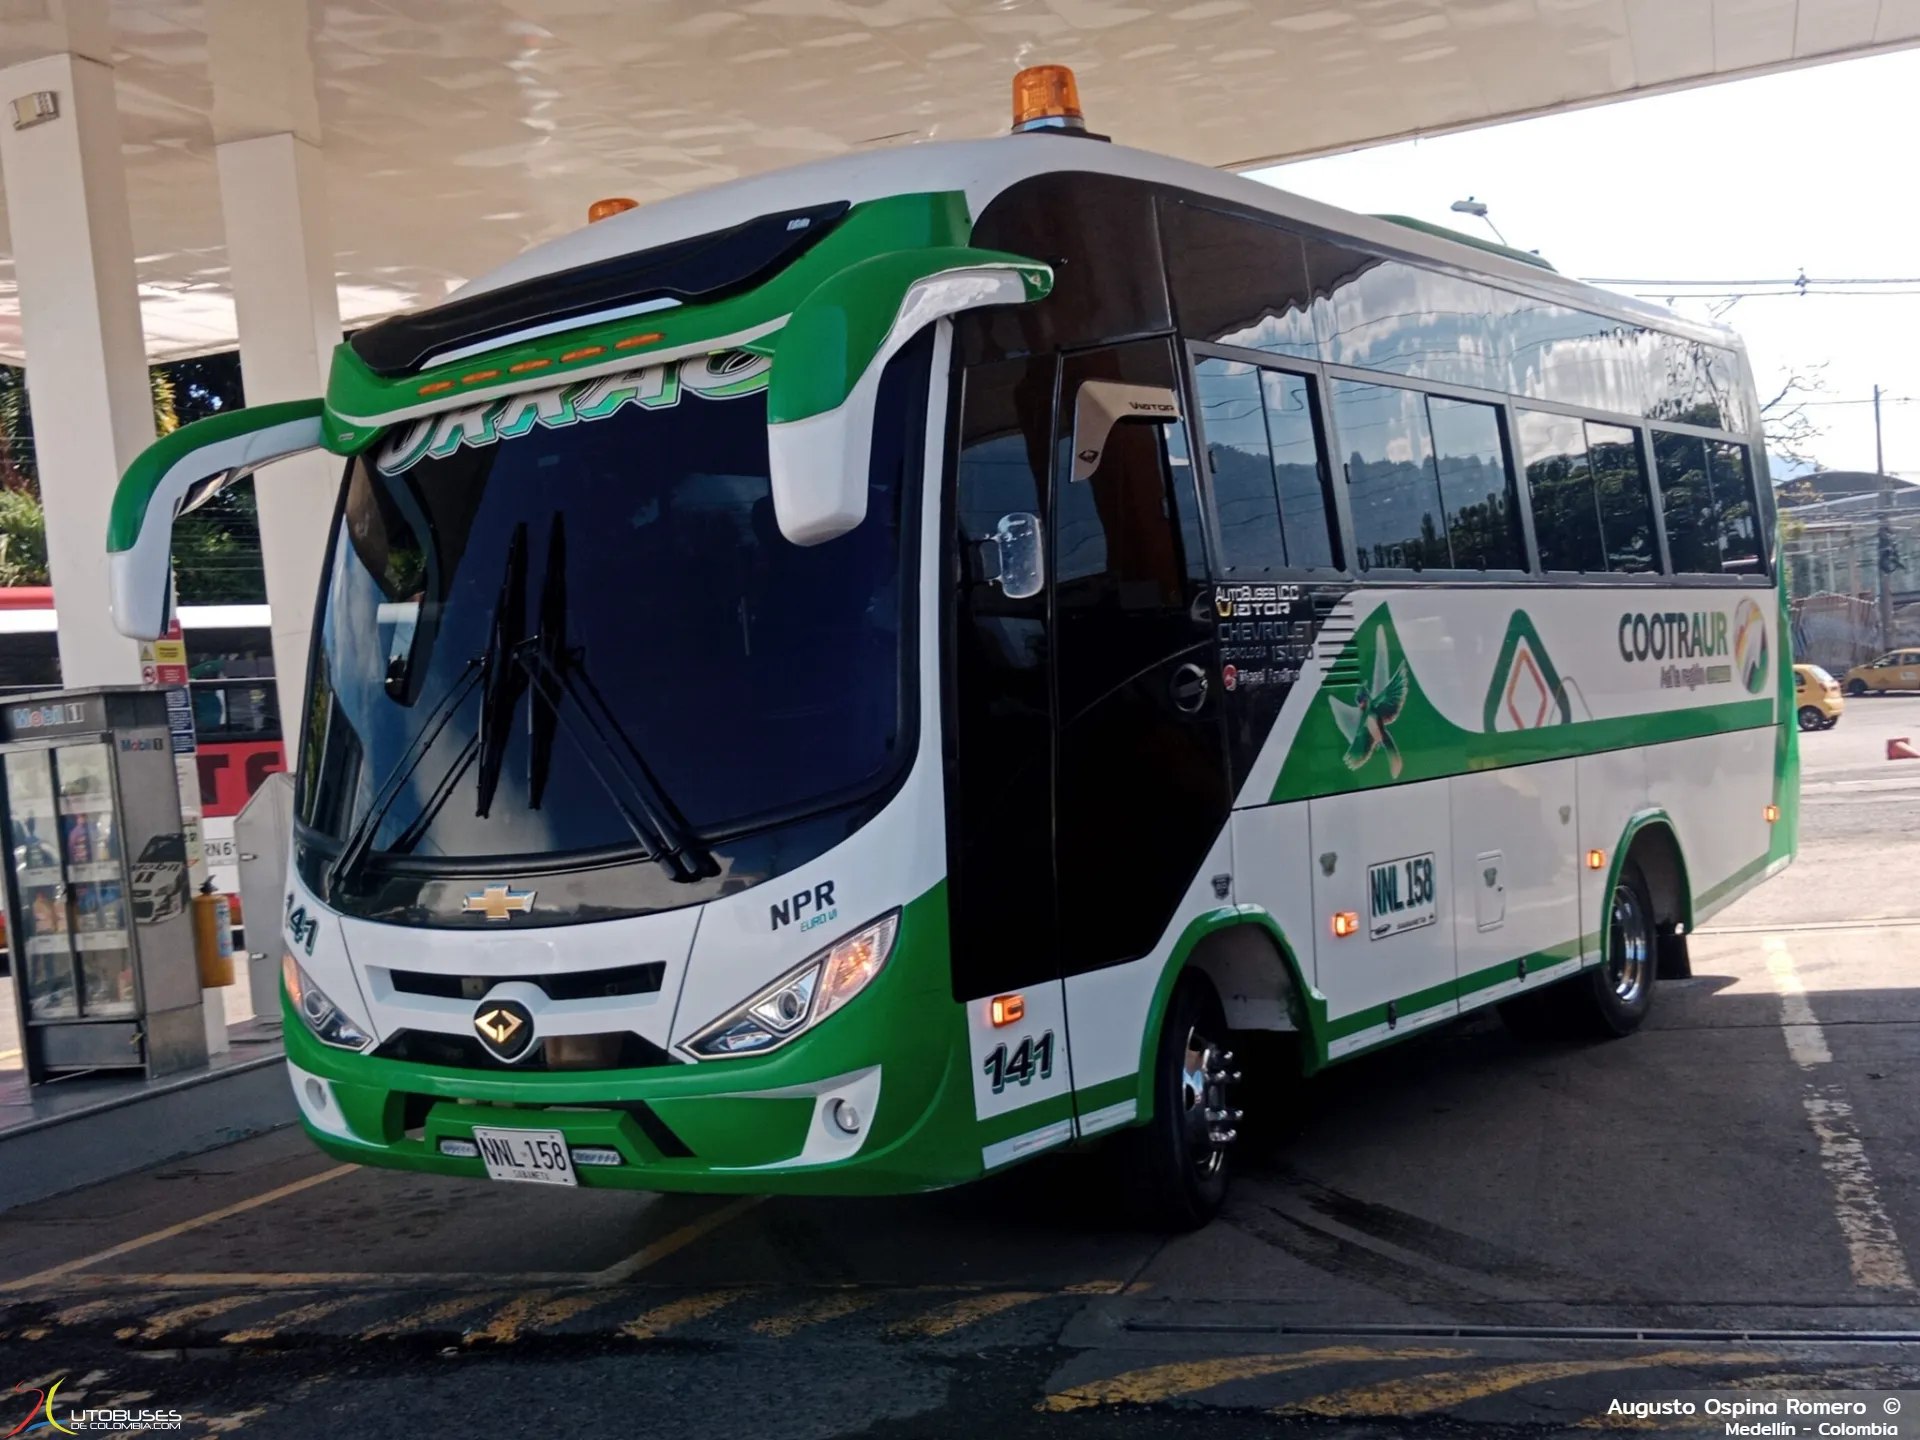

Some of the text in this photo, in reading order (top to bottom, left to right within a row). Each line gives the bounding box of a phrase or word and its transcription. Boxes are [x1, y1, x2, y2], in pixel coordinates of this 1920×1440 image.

[1618, 612, 1729, 663] COOTRAUR
[769, 879, 836, 932] NPR
[1370, 857, 1435, 918] NNL 158
[983, 1028, 1055, 1095] 141
[479, 1137, 567, 1171] NNL 158
